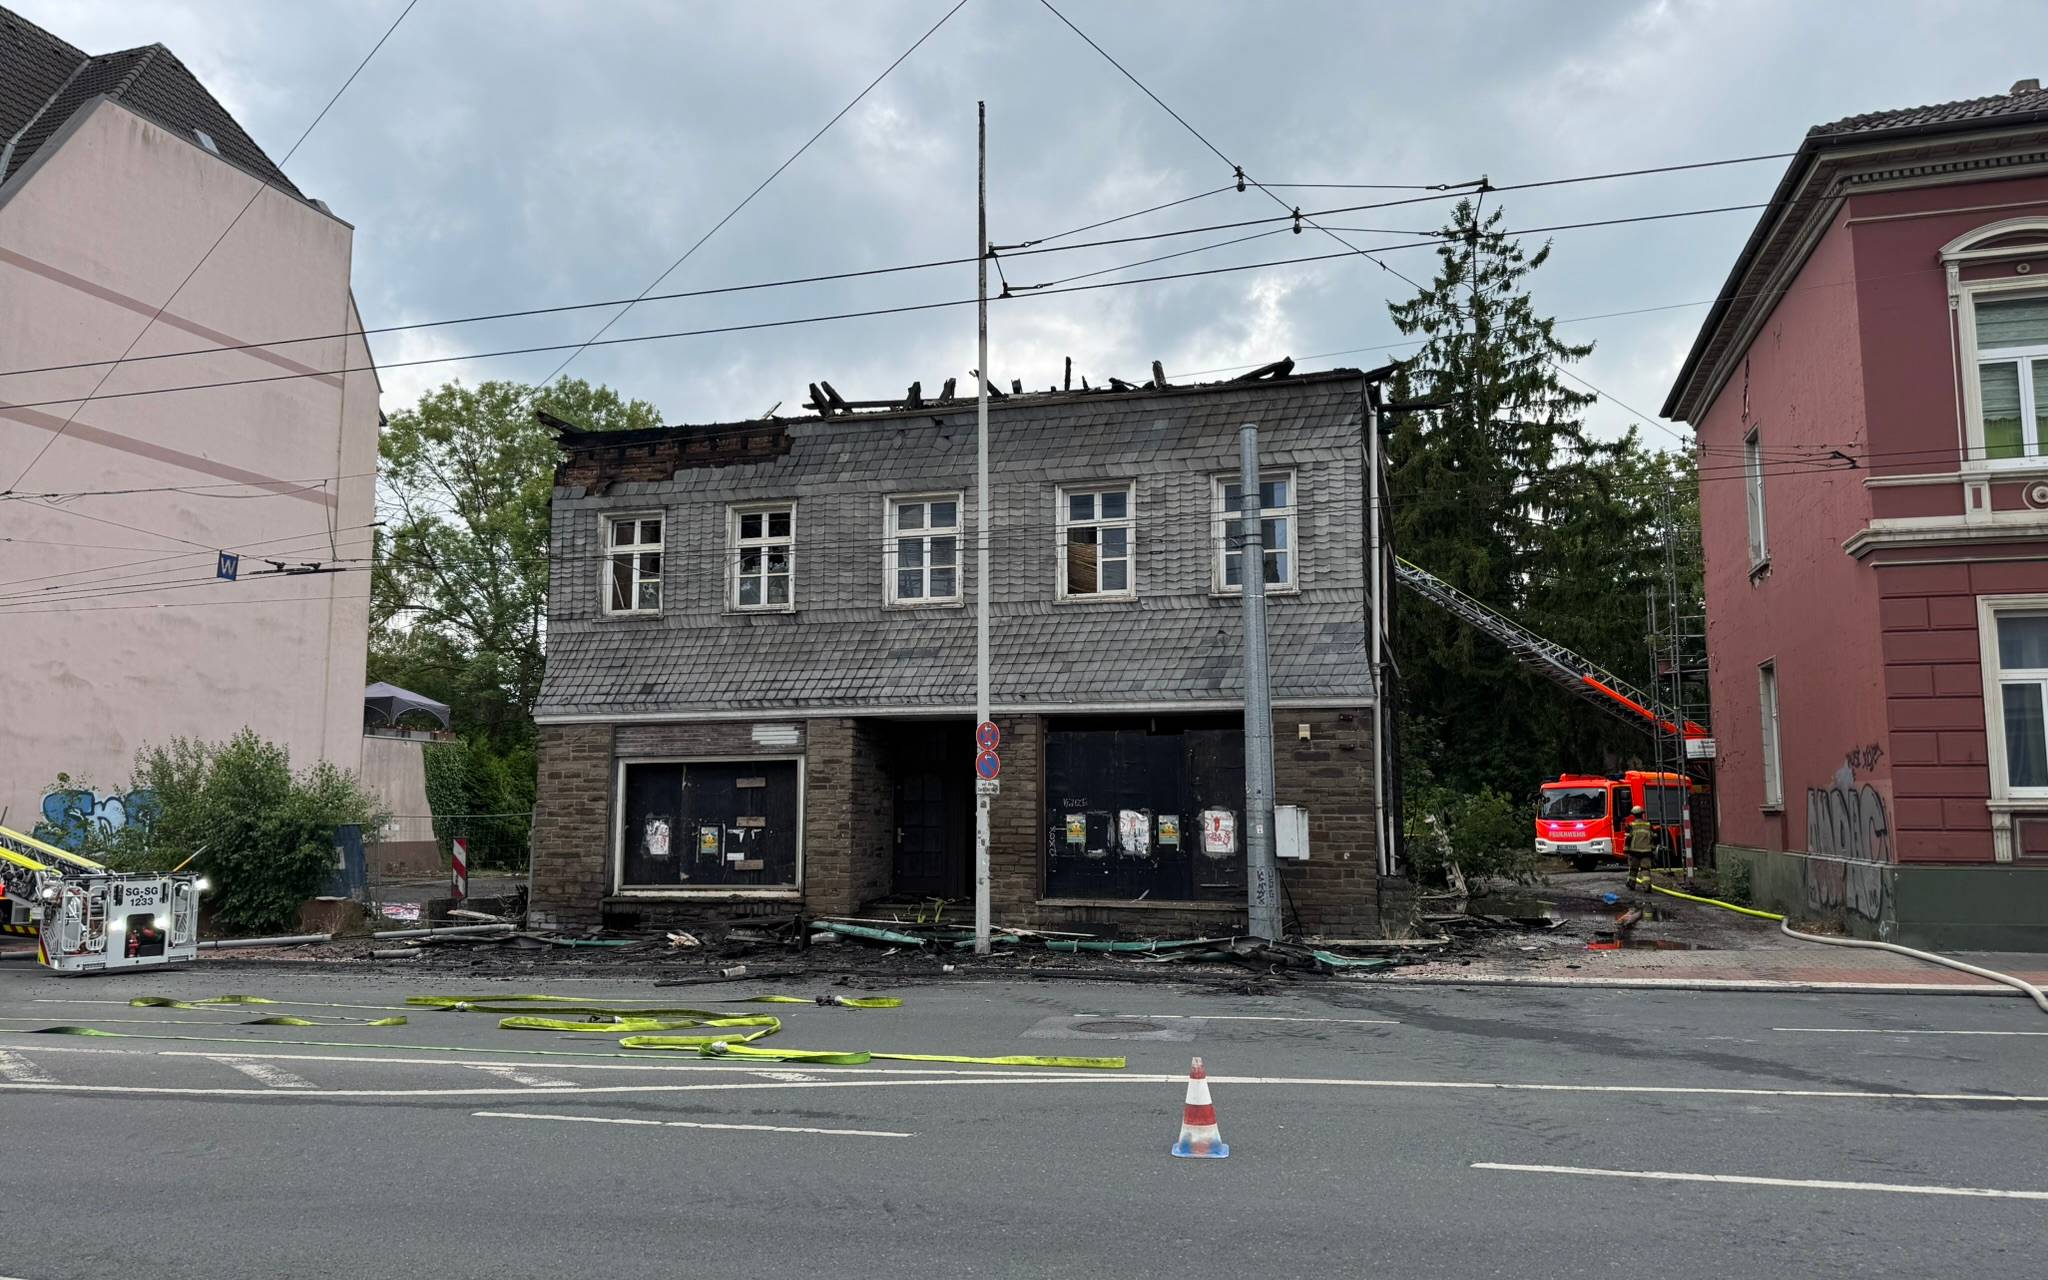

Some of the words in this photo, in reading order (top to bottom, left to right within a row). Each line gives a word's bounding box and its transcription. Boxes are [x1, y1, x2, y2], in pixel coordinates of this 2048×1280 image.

[220, 557, 237, 576] W
[125, 886, 158, 896] SG-SG
[130, 897, 154, 907] 1233
